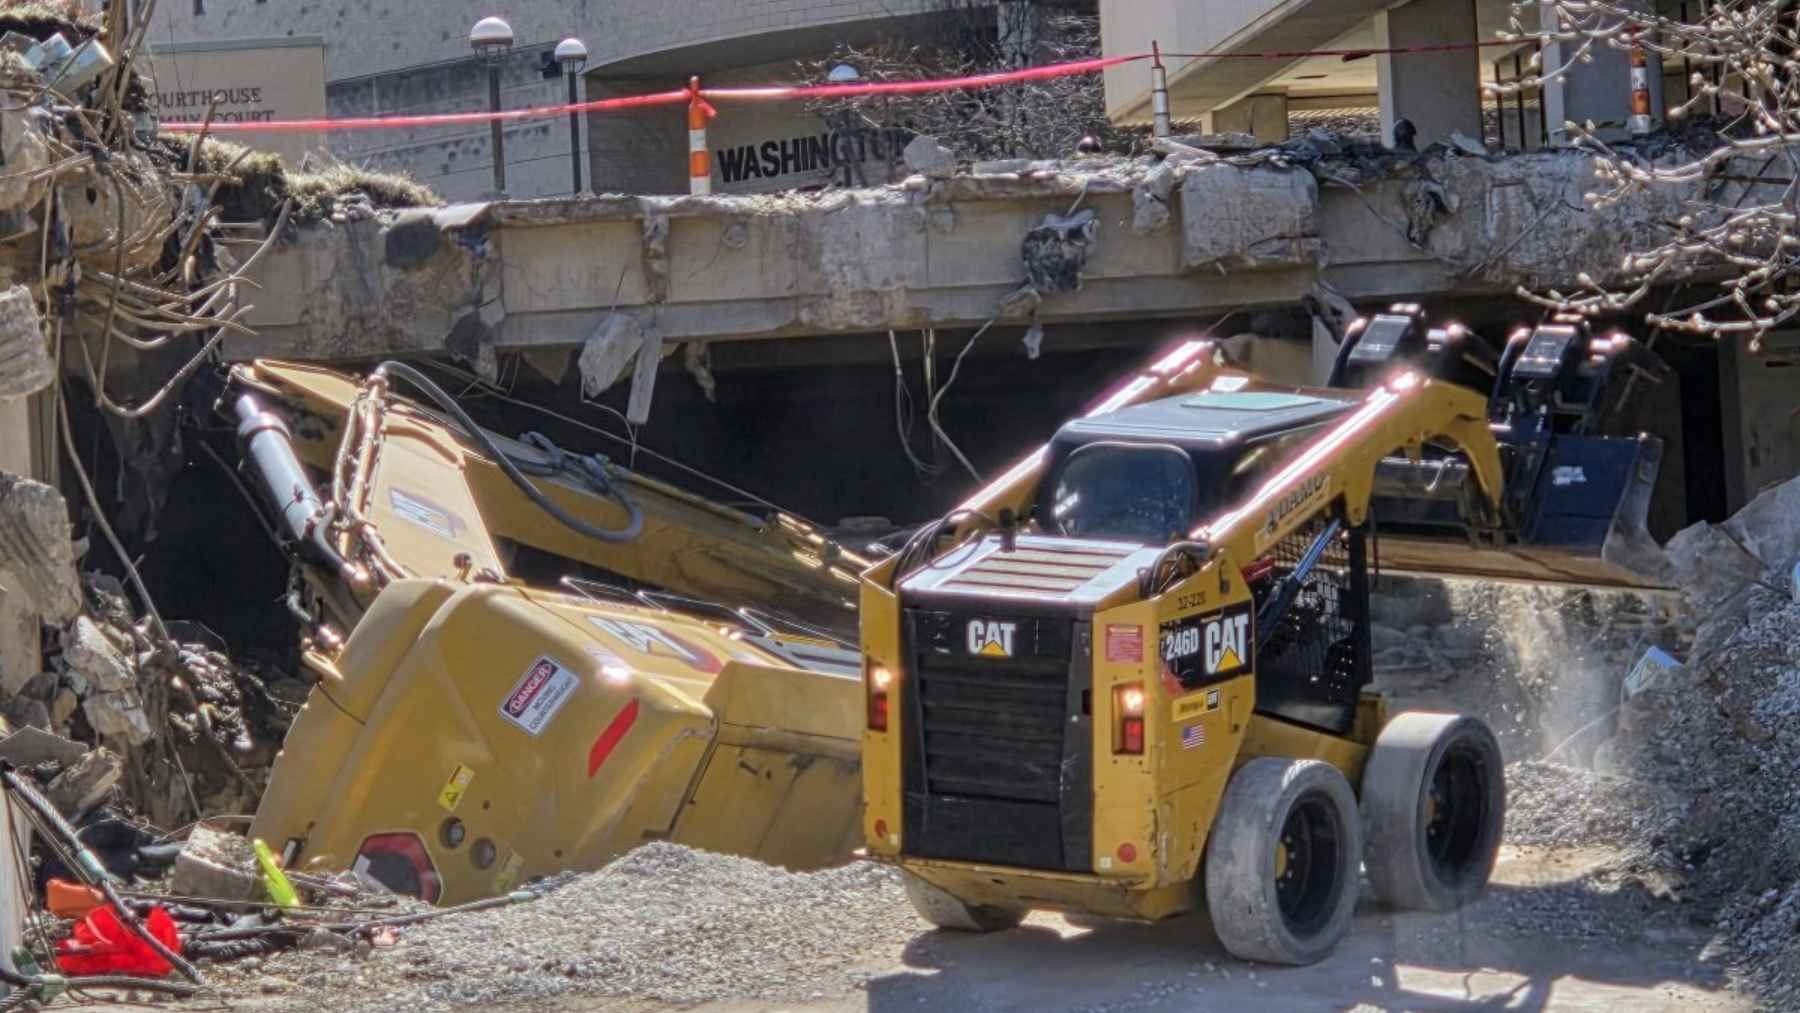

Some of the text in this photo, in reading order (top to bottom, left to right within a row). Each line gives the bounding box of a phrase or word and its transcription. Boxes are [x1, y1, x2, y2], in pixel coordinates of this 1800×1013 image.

[968, 620, 1016, 656] CAT
[1166, 628, 1199, 661] 246D
[1205, 614, 1249, 674] CAT
[511, 664, 552, 712] DANGER
